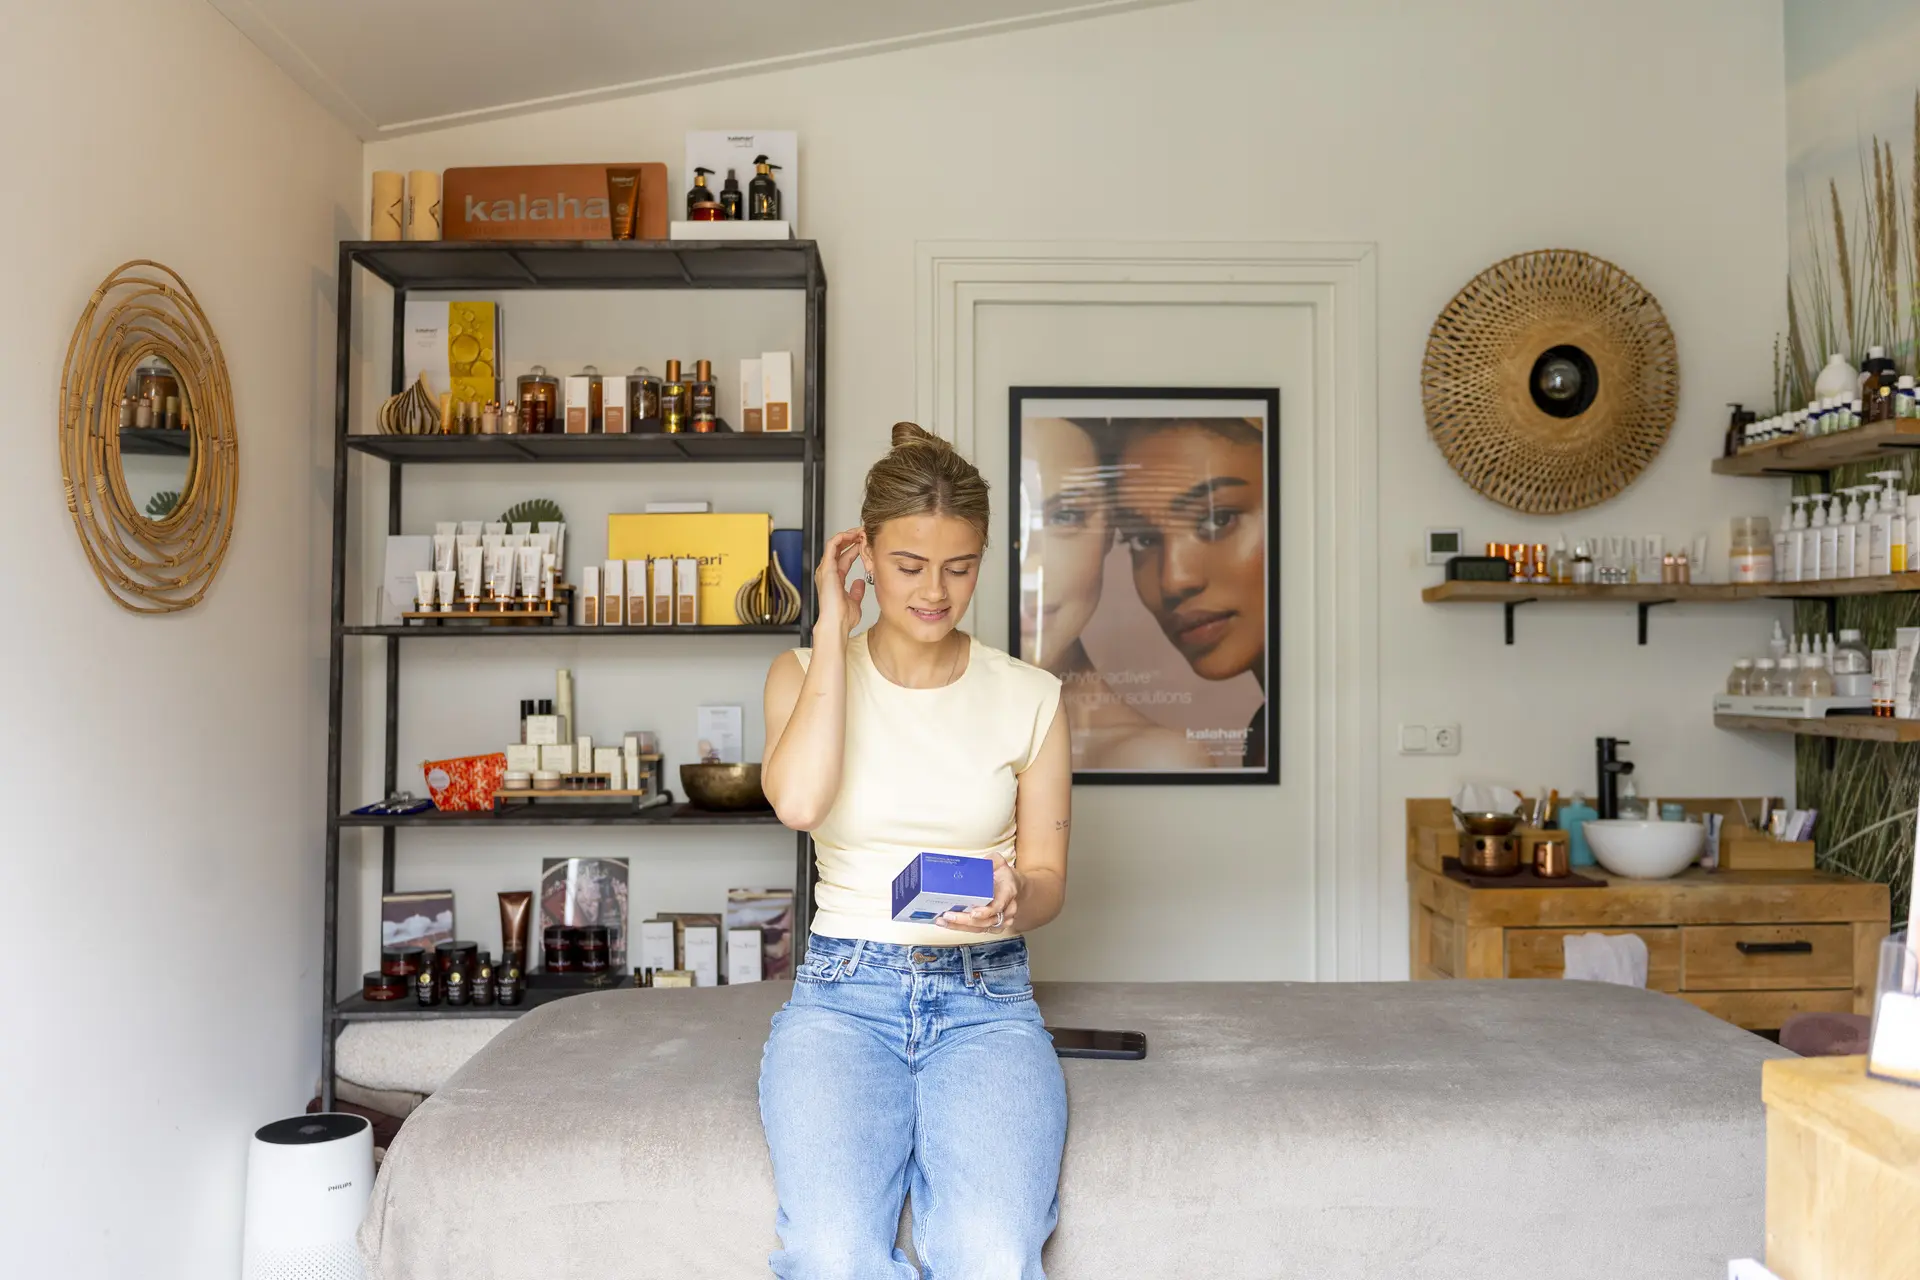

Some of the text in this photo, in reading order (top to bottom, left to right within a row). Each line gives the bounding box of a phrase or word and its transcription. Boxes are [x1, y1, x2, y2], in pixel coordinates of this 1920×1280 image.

[464, 192, 610, 222] kalaha
[1126, 690, 1192, 704] solutions
[1186, 727, 1248, 740] kalahari
[327, 1181, 352, 1191] PHILIPS
